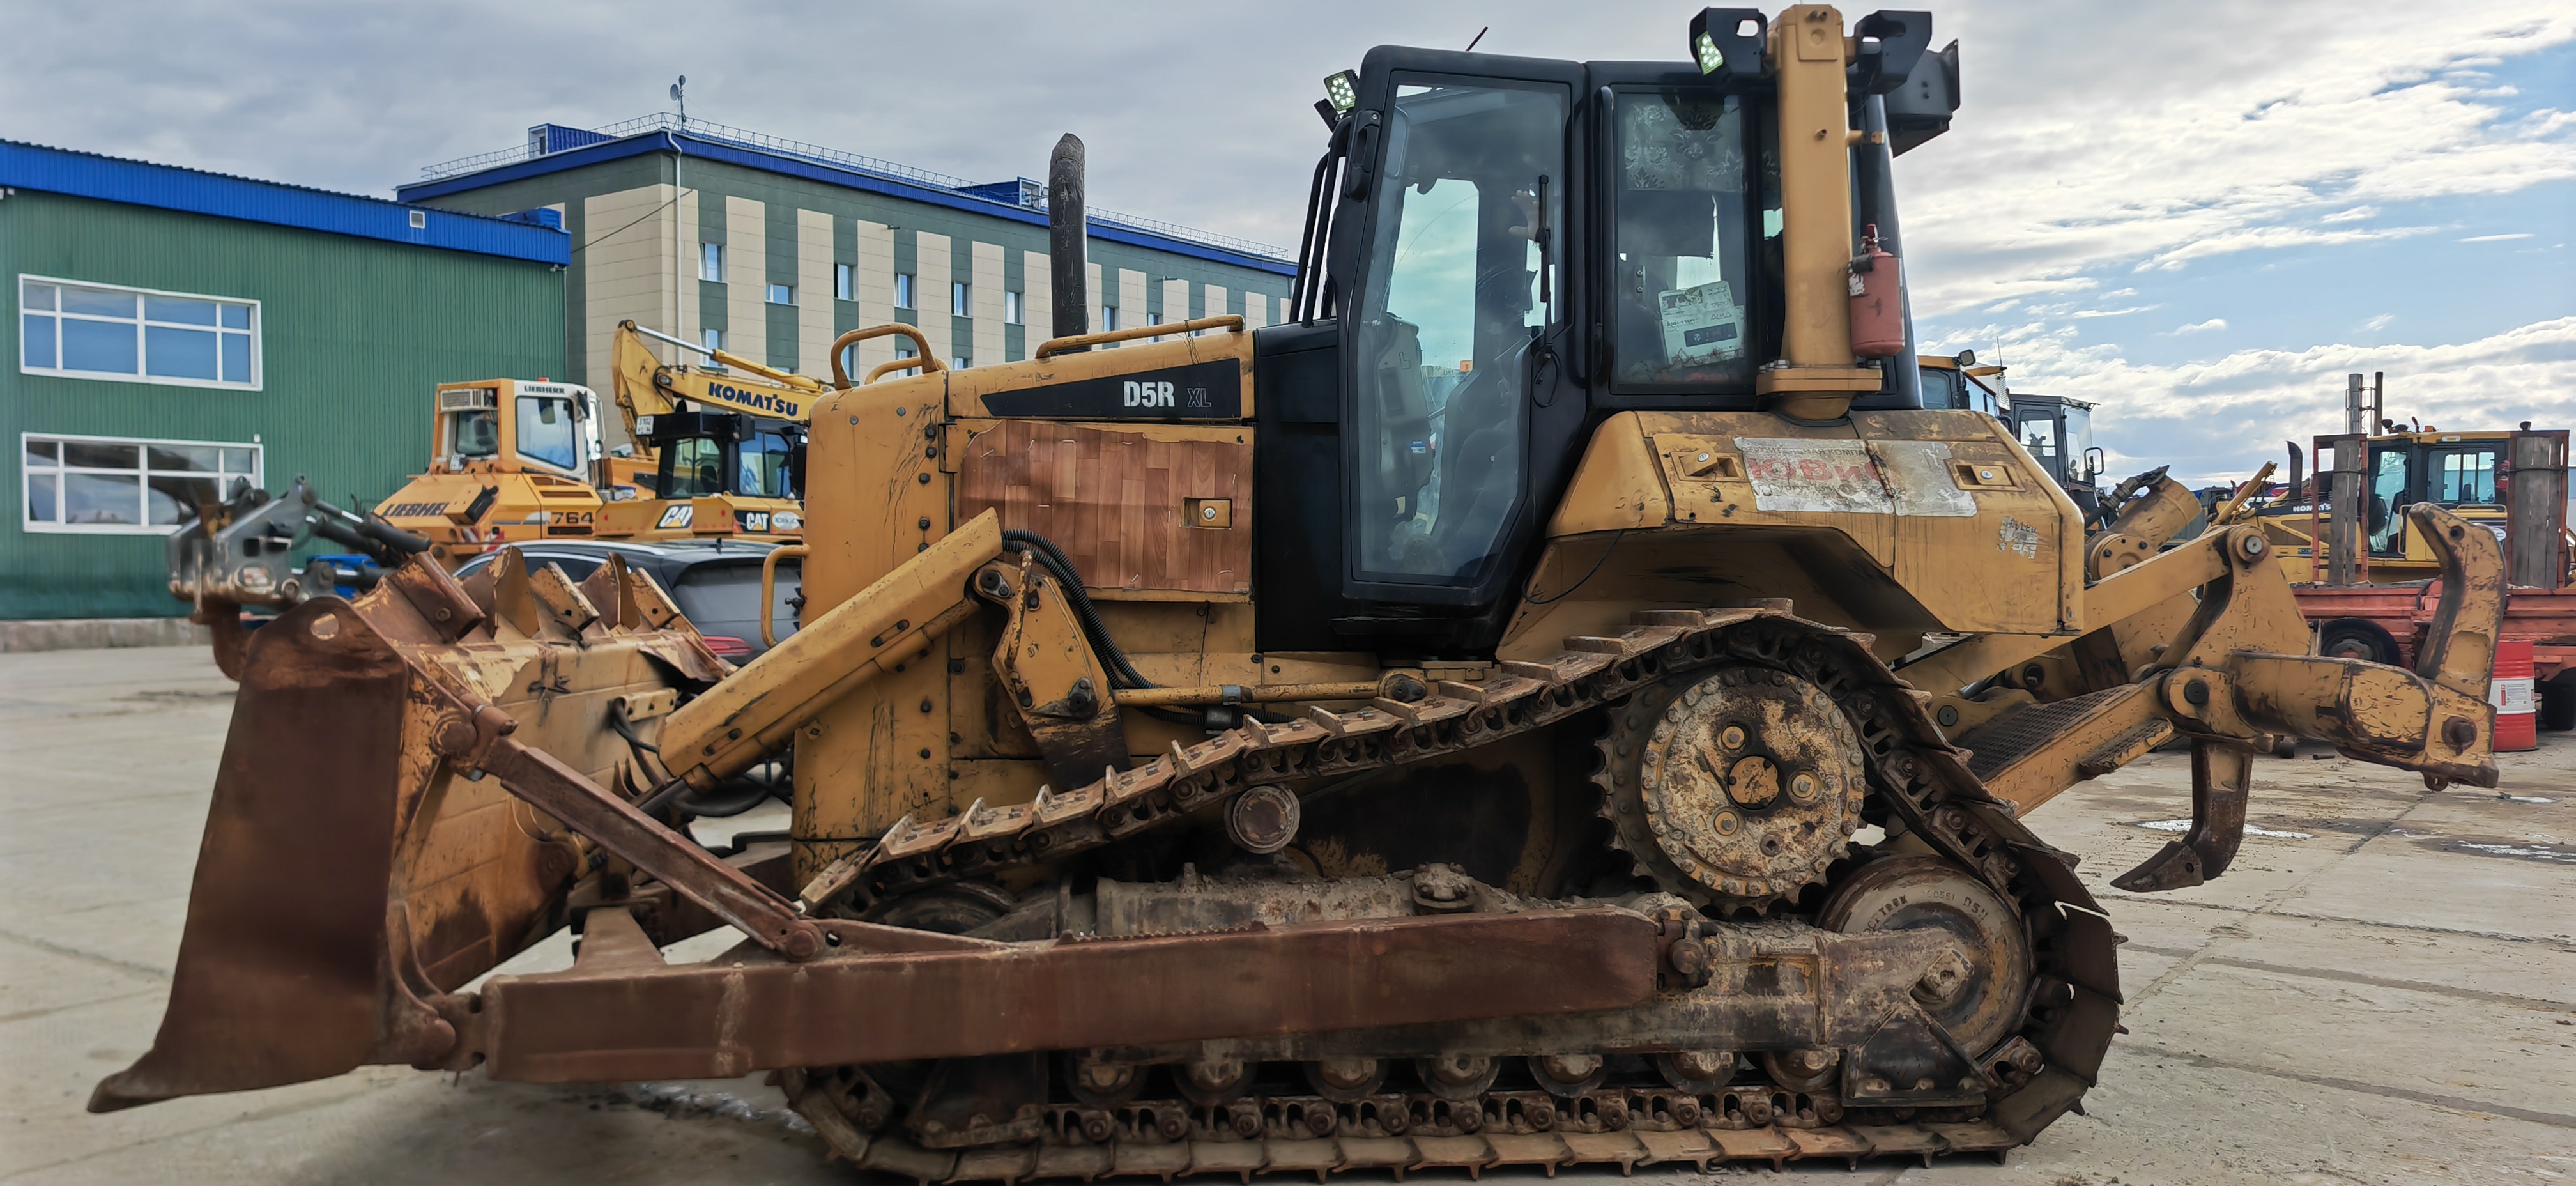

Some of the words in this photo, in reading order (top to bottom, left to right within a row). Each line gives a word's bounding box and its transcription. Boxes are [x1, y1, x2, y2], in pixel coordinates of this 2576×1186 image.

[524, 385, 565, 394] LIEBHERR
[1123, 381, 1176, 408] D5R
[1186, 387, 1211, 408] XL
[707, 381, 799, 417] KOMATSU
[381, 502, 450, 517] LIEBHE
[2292, 503, 2331, 512] KOMTS
[552, 512, 595, 524] 764
[746, 512, 769, 530] CAT
